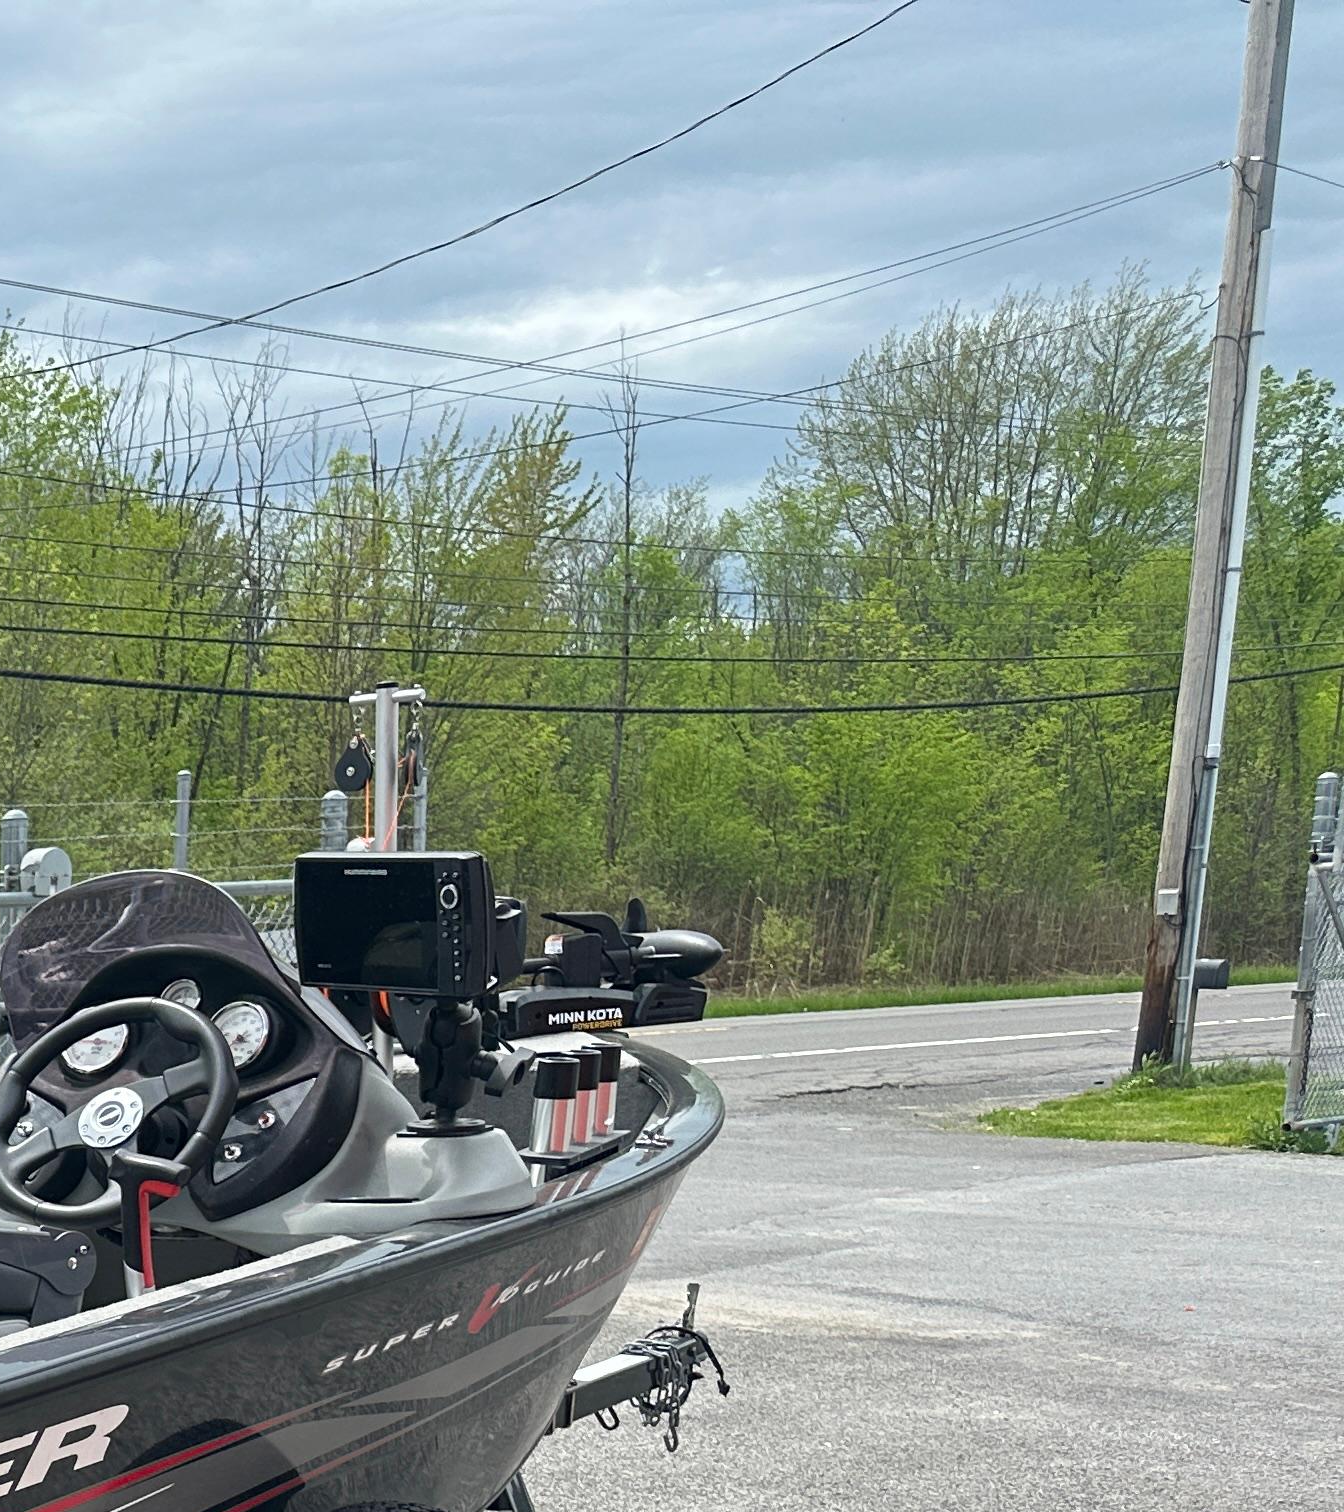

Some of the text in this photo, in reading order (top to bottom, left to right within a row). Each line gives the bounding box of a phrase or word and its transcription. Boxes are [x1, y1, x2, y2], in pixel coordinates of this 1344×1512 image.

[548, 1007, 623, 1026] MINN KOTA
[320, 1311, 461, 1377] SUPER
[522, 1249, 607, 1297] GUIDE
